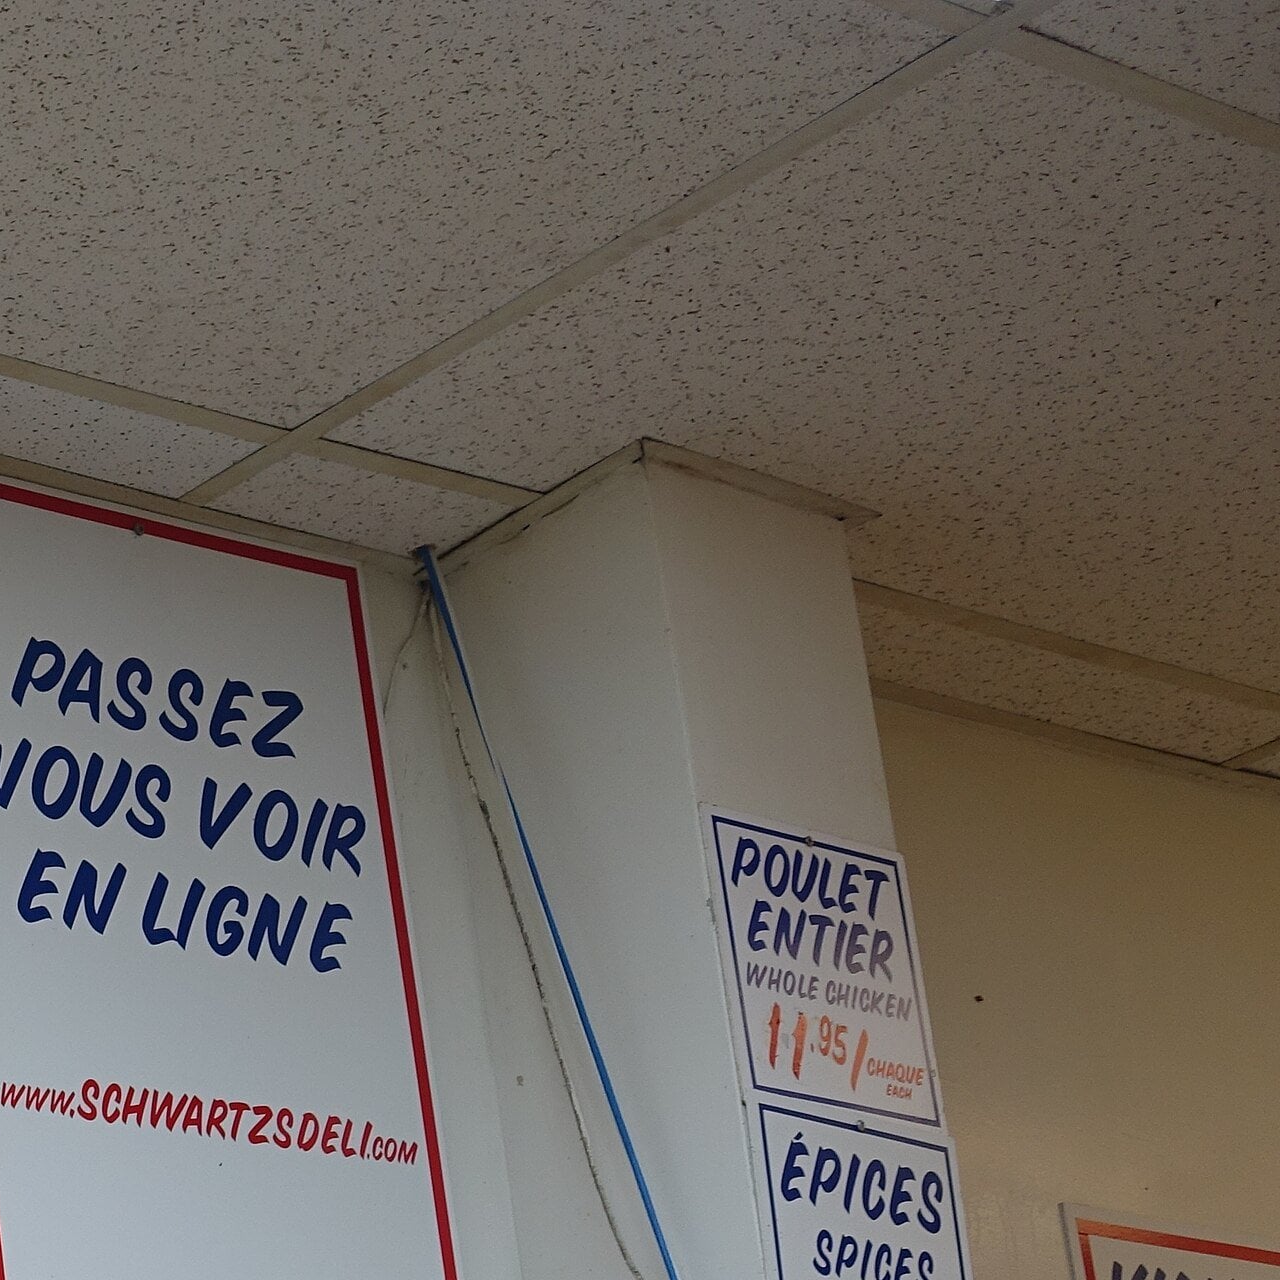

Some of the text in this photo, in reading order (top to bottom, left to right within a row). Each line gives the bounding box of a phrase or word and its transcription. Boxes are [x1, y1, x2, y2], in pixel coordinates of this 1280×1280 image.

[11, 635, 303, 759] PASSEZ
[199, 777, 366, 877] VOIR
[16, 849, 352, 973] EN LIGNE
[731, 836, 889, 921] POULET
[747, 899, 894, 982] ENTIER
[746, 962, 914, 1021] WHOLE CHICKEN
[867, 1058, 925, 1086] CHAQUE
[886, 1084, 912, 1099] EACH
[781, 1132, 943, 1234] ÉPICES
